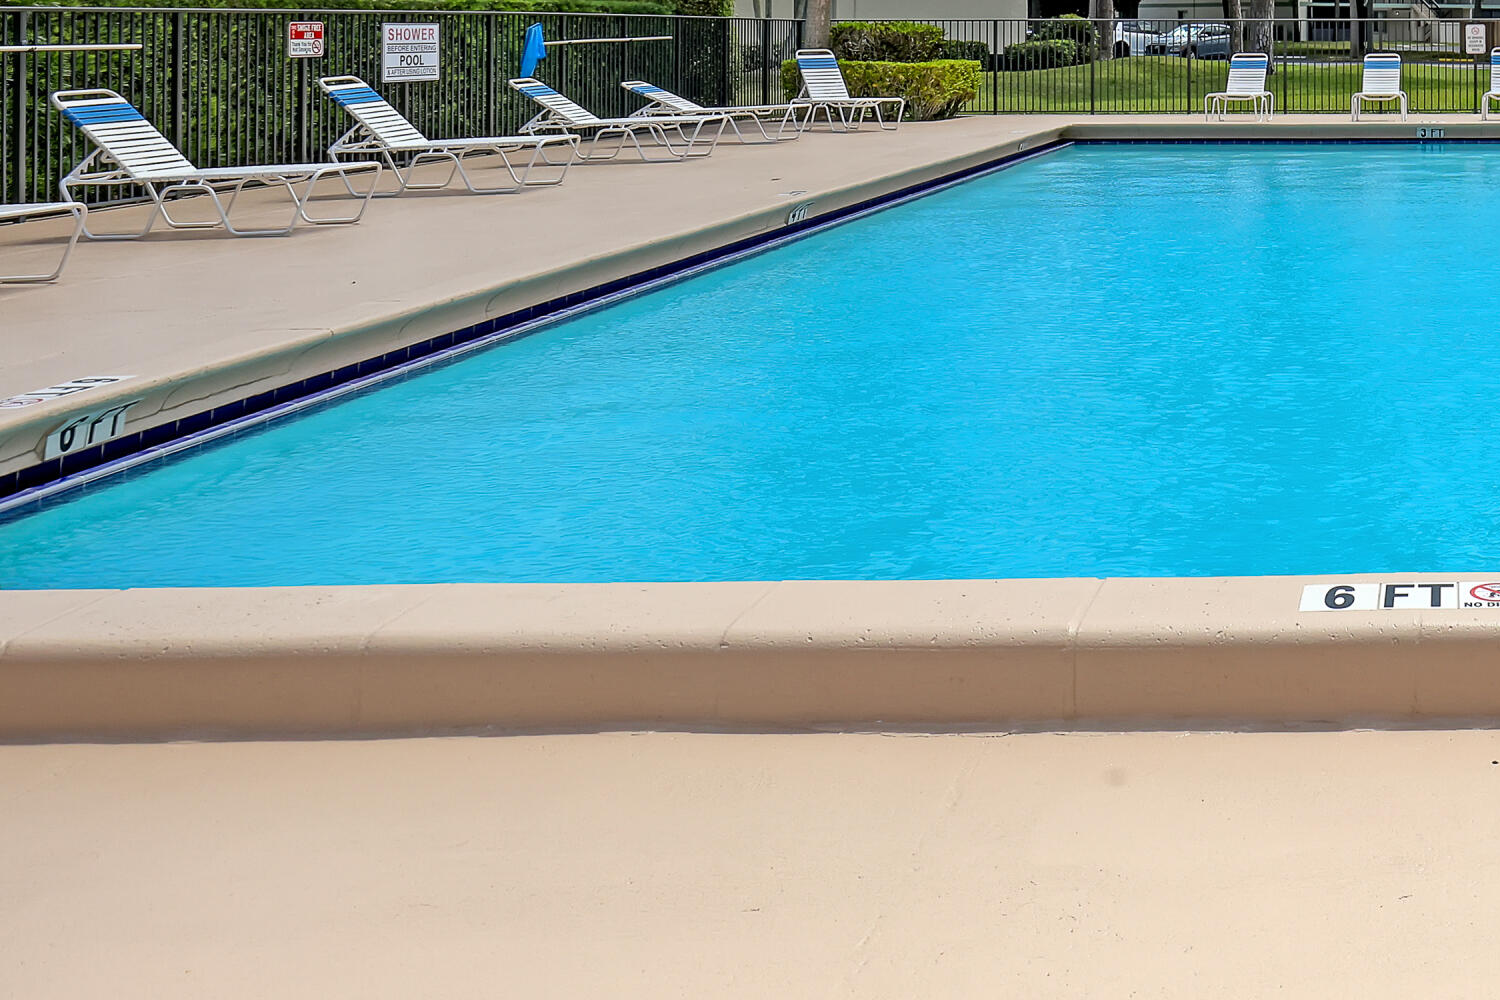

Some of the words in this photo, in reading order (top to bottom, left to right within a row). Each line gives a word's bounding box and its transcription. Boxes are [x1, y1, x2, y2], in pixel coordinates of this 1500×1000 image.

[388, 28, 435, 41] SHOWER
[399, 54, 425, 66] POOL
[1420, 128, 1427, 138] 3
[1431, 128, 1443, 138] FT
[1323, 585, 1356, 610] 6
[1383, 583, 1455, 608] FT
